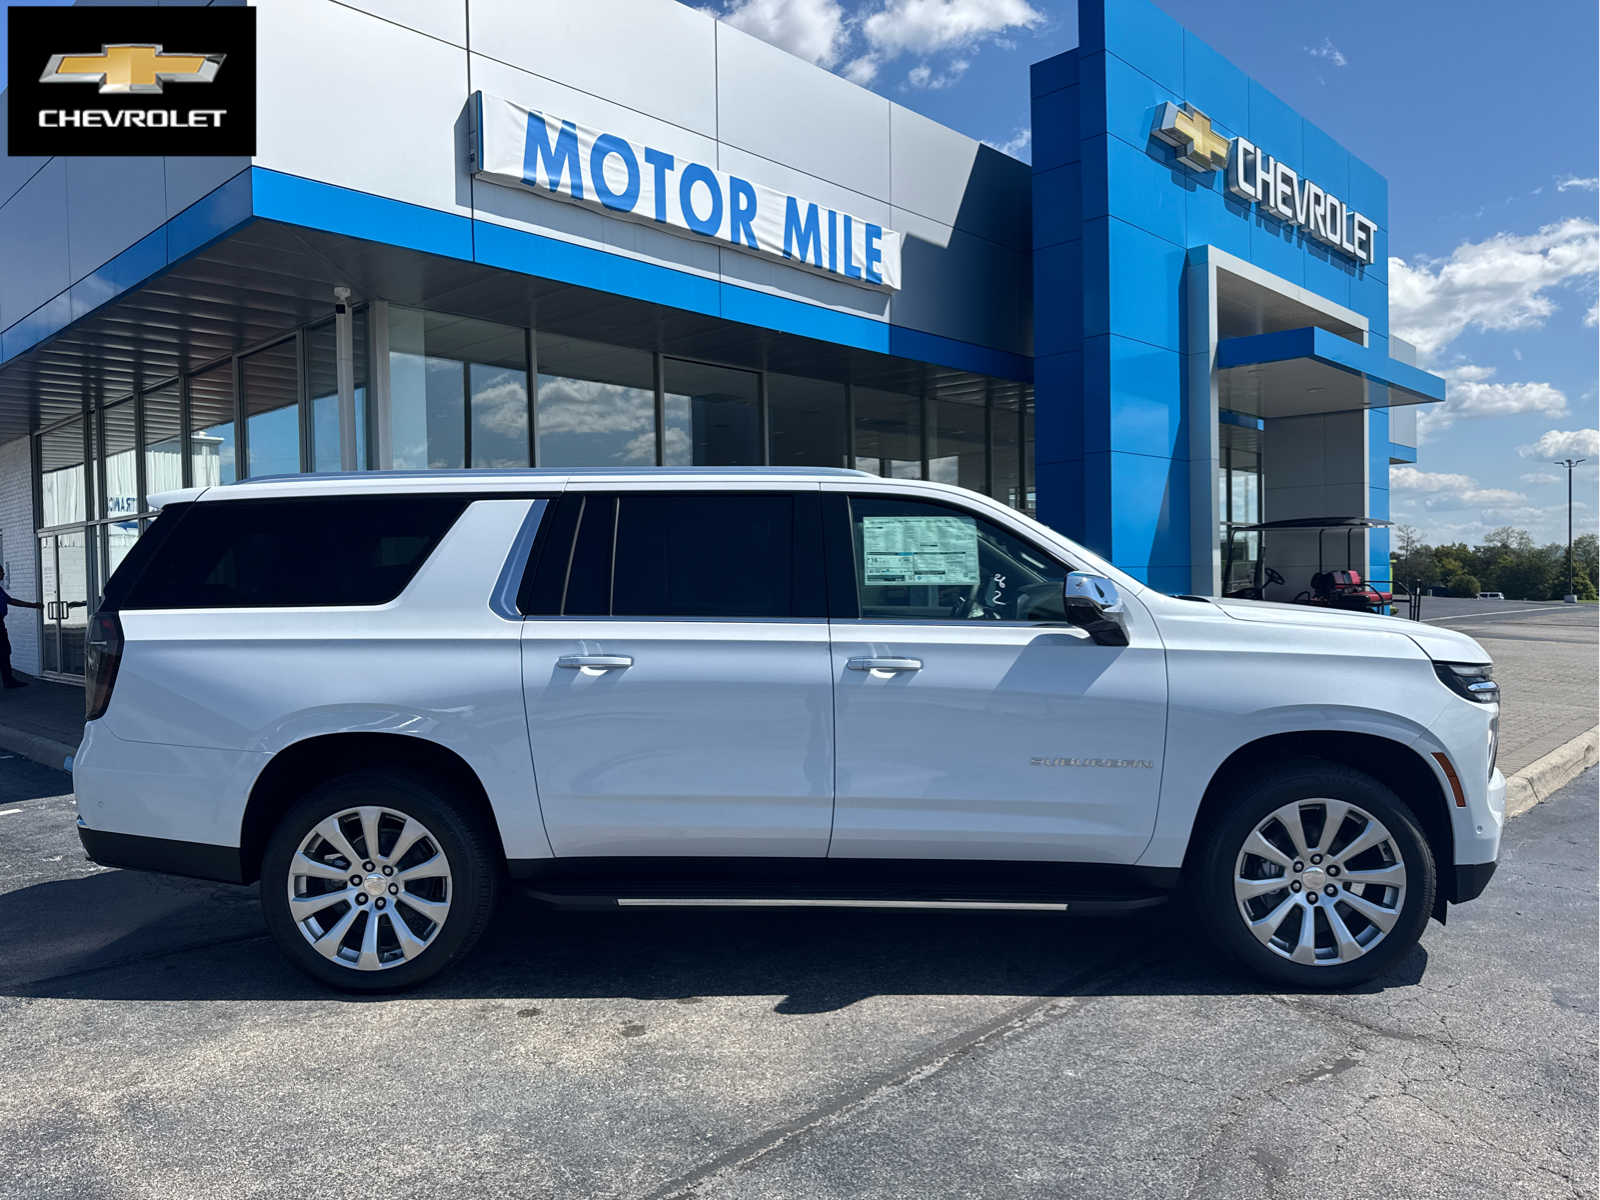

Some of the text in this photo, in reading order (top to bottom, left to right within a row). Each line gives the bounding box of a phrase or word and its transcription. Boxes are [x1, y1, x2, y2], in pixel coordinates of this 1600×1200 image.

[520, 110, 883, 286] MOTOR MILE
[1229, 136, 1378, 265] CHEVROLET
[1030, 757, 1153, 769] SUBURBAN
